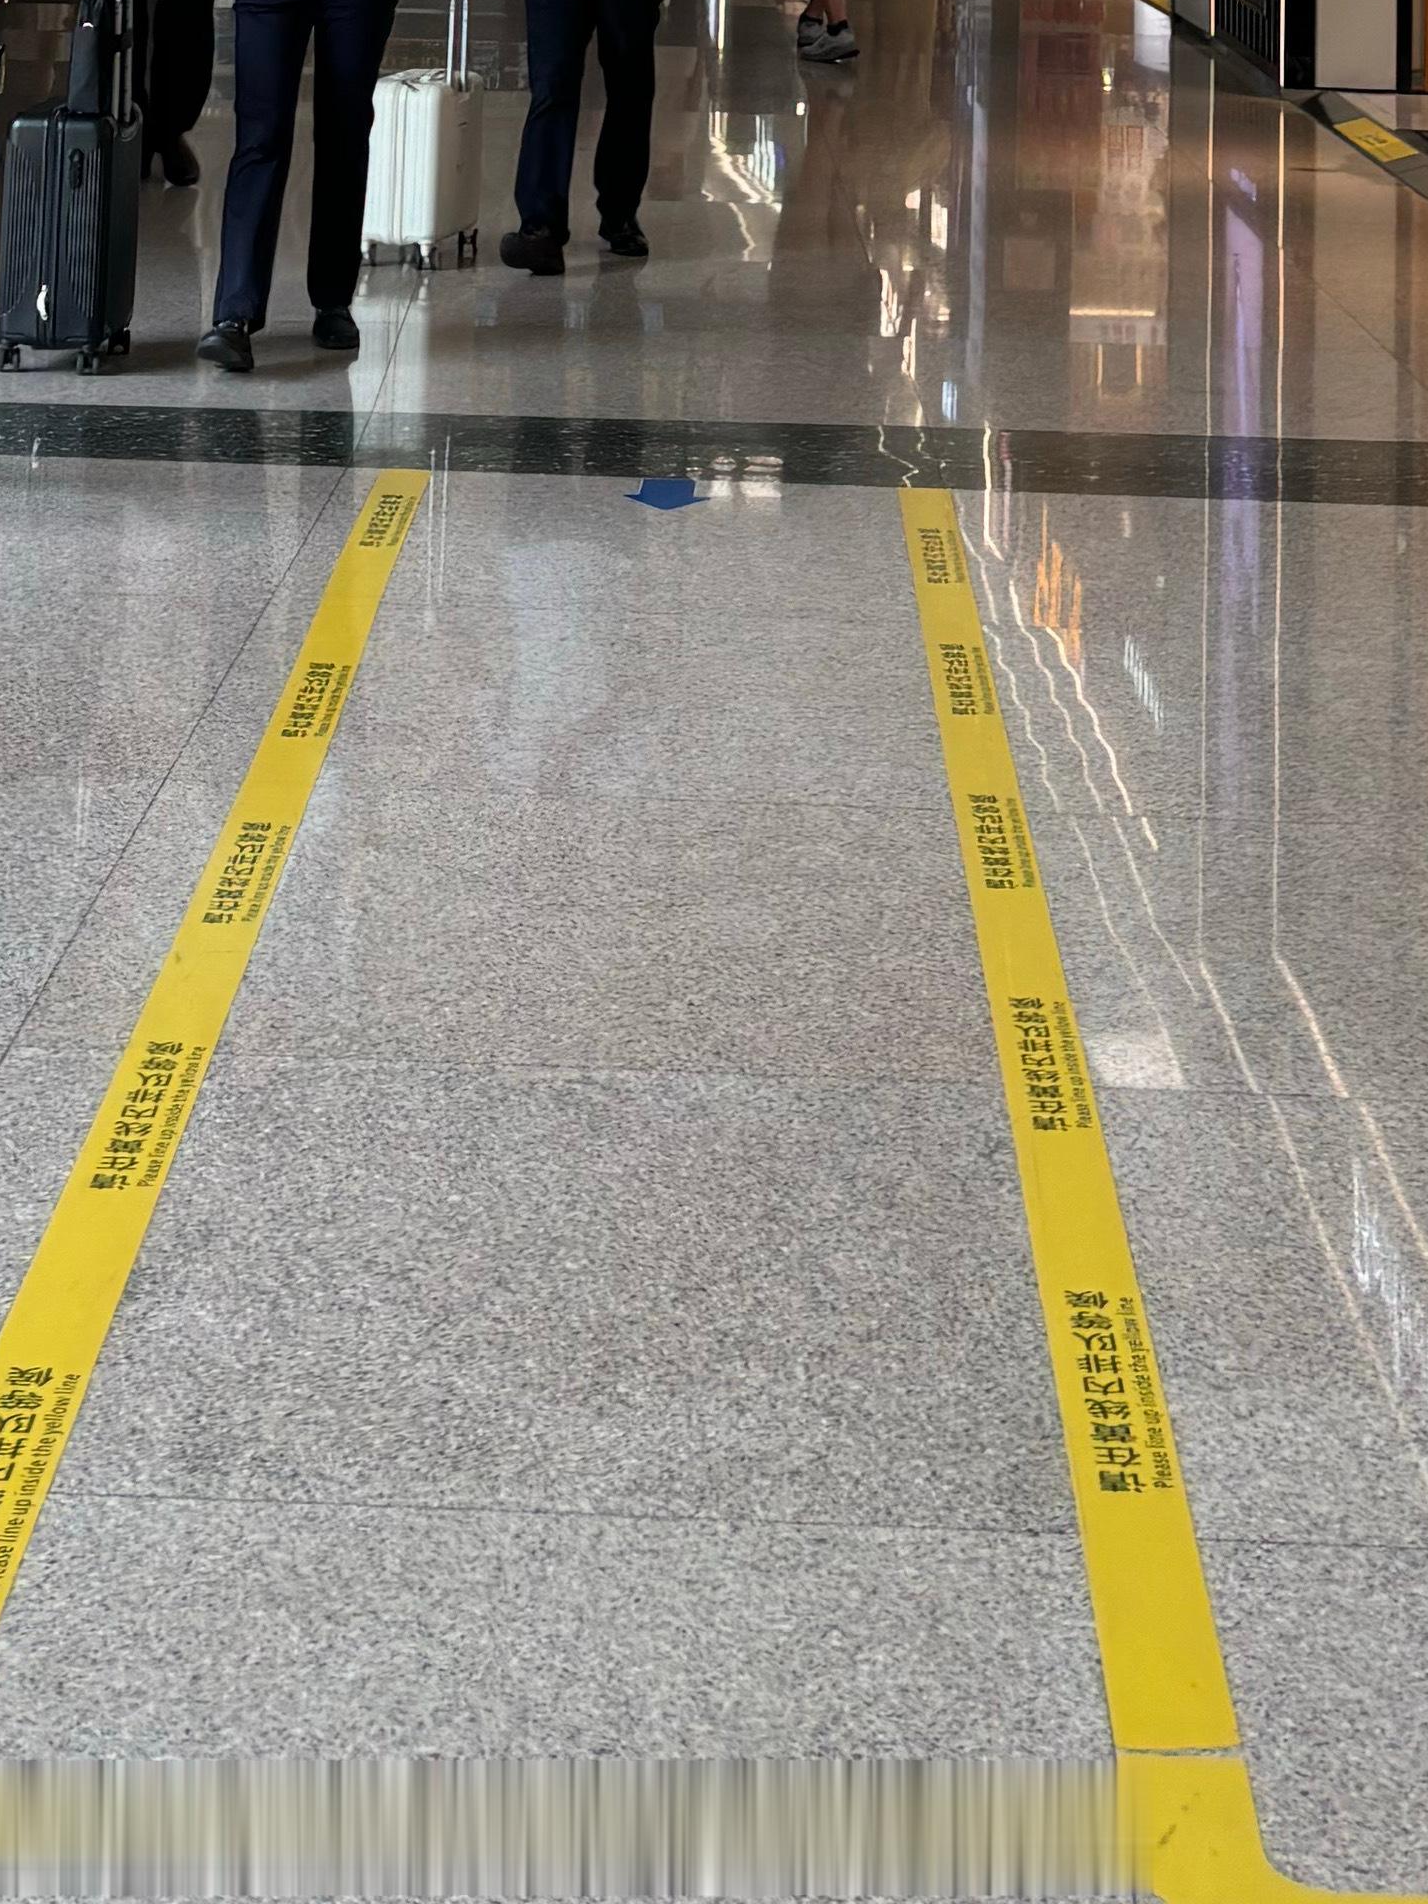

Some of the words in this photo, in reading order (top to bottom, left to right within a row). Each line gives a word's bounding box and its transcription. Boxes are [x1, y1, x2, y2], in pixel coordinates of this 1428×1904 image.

[54, 1373, 82, 1395] line
[1065, 1290, 1147, 1494] 请在黄线内排队等候
[42, 1396, 71, 1435] yellow
[31, 1437, 57, 1458] the
[15, 1459, 48, 1496] inside
[12, 1498, 32, 1516] up
